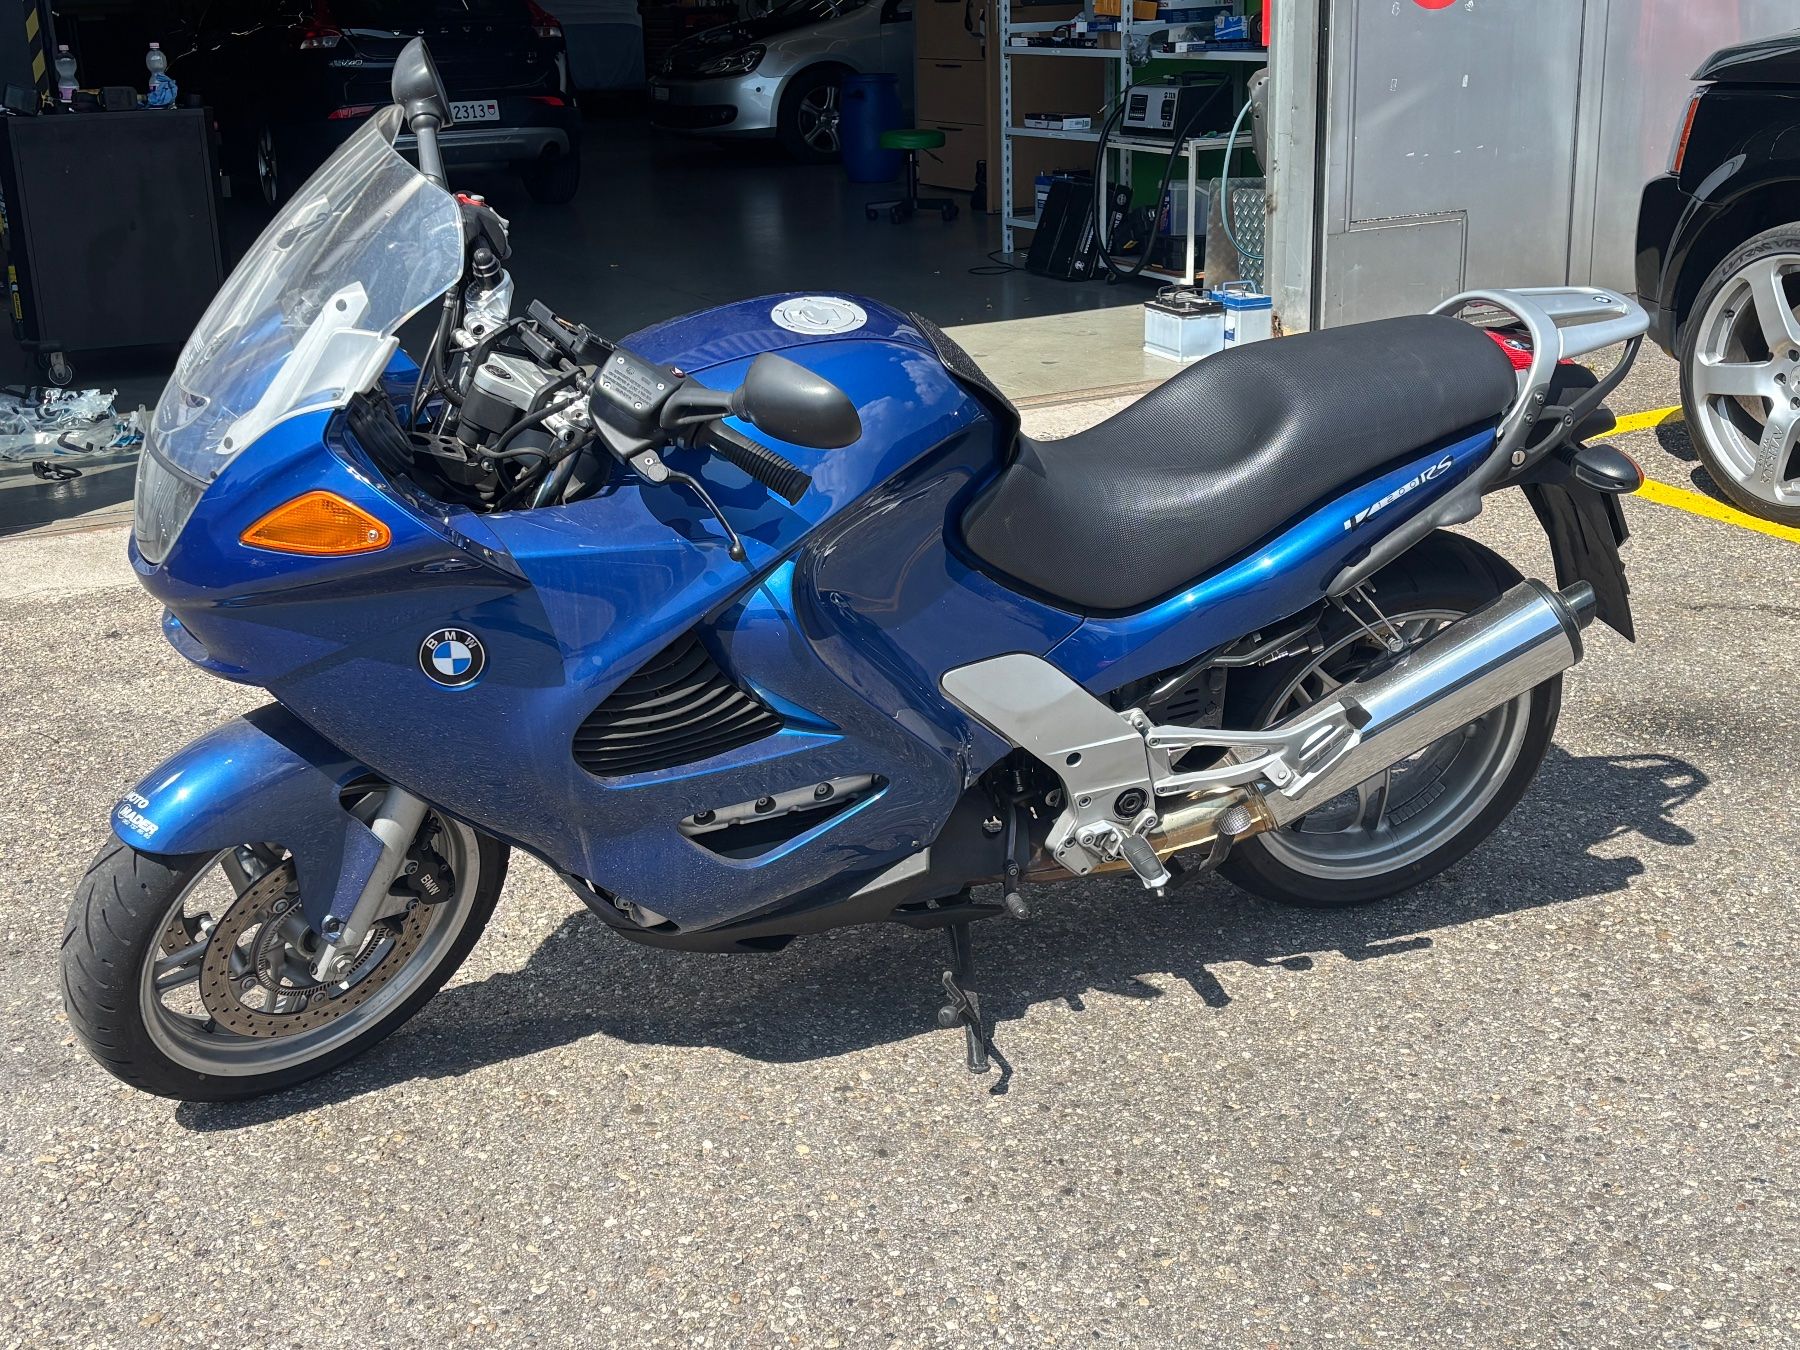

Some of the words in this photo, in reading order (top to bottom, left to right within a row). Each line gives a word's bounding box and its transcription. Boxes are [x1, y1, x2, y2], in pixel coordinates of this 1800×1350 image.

[453, 104, 486, 120] 2313
[426, 630, 477, 650] BMW
[122, 790, 149, 809] MOTO
[118, 804, 159, 835] MADER
[420, 873, 441, 896] BMW
